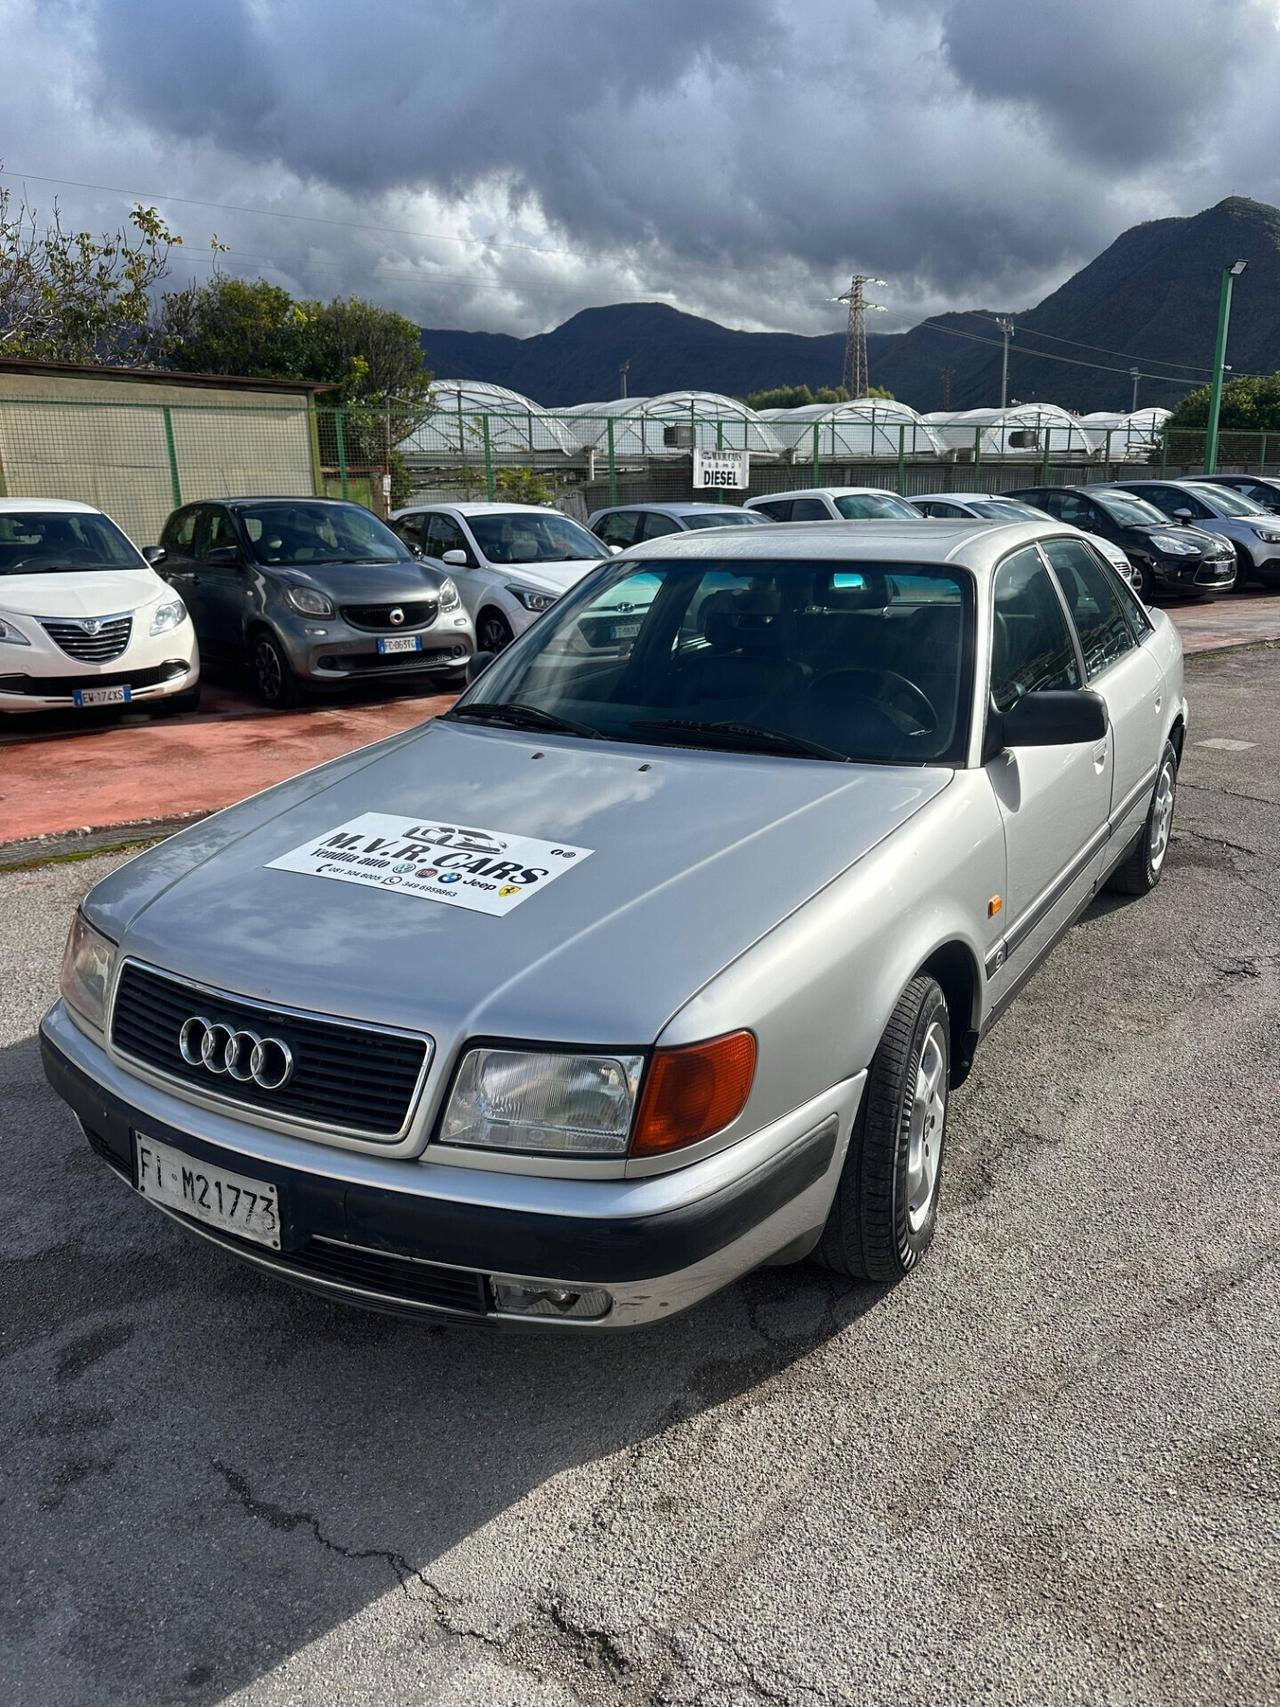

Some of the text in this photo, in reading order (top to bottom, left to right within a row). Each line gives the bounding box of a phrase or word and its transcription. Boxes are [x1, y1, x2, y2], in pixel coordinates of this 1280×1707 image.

[703, 470, 738, 486] DIESEL
[310, 848, 391, 868] Vendita auto
[463, 878, 497, 891] Jeep
[181, 1166, 276, 1231] M21773
